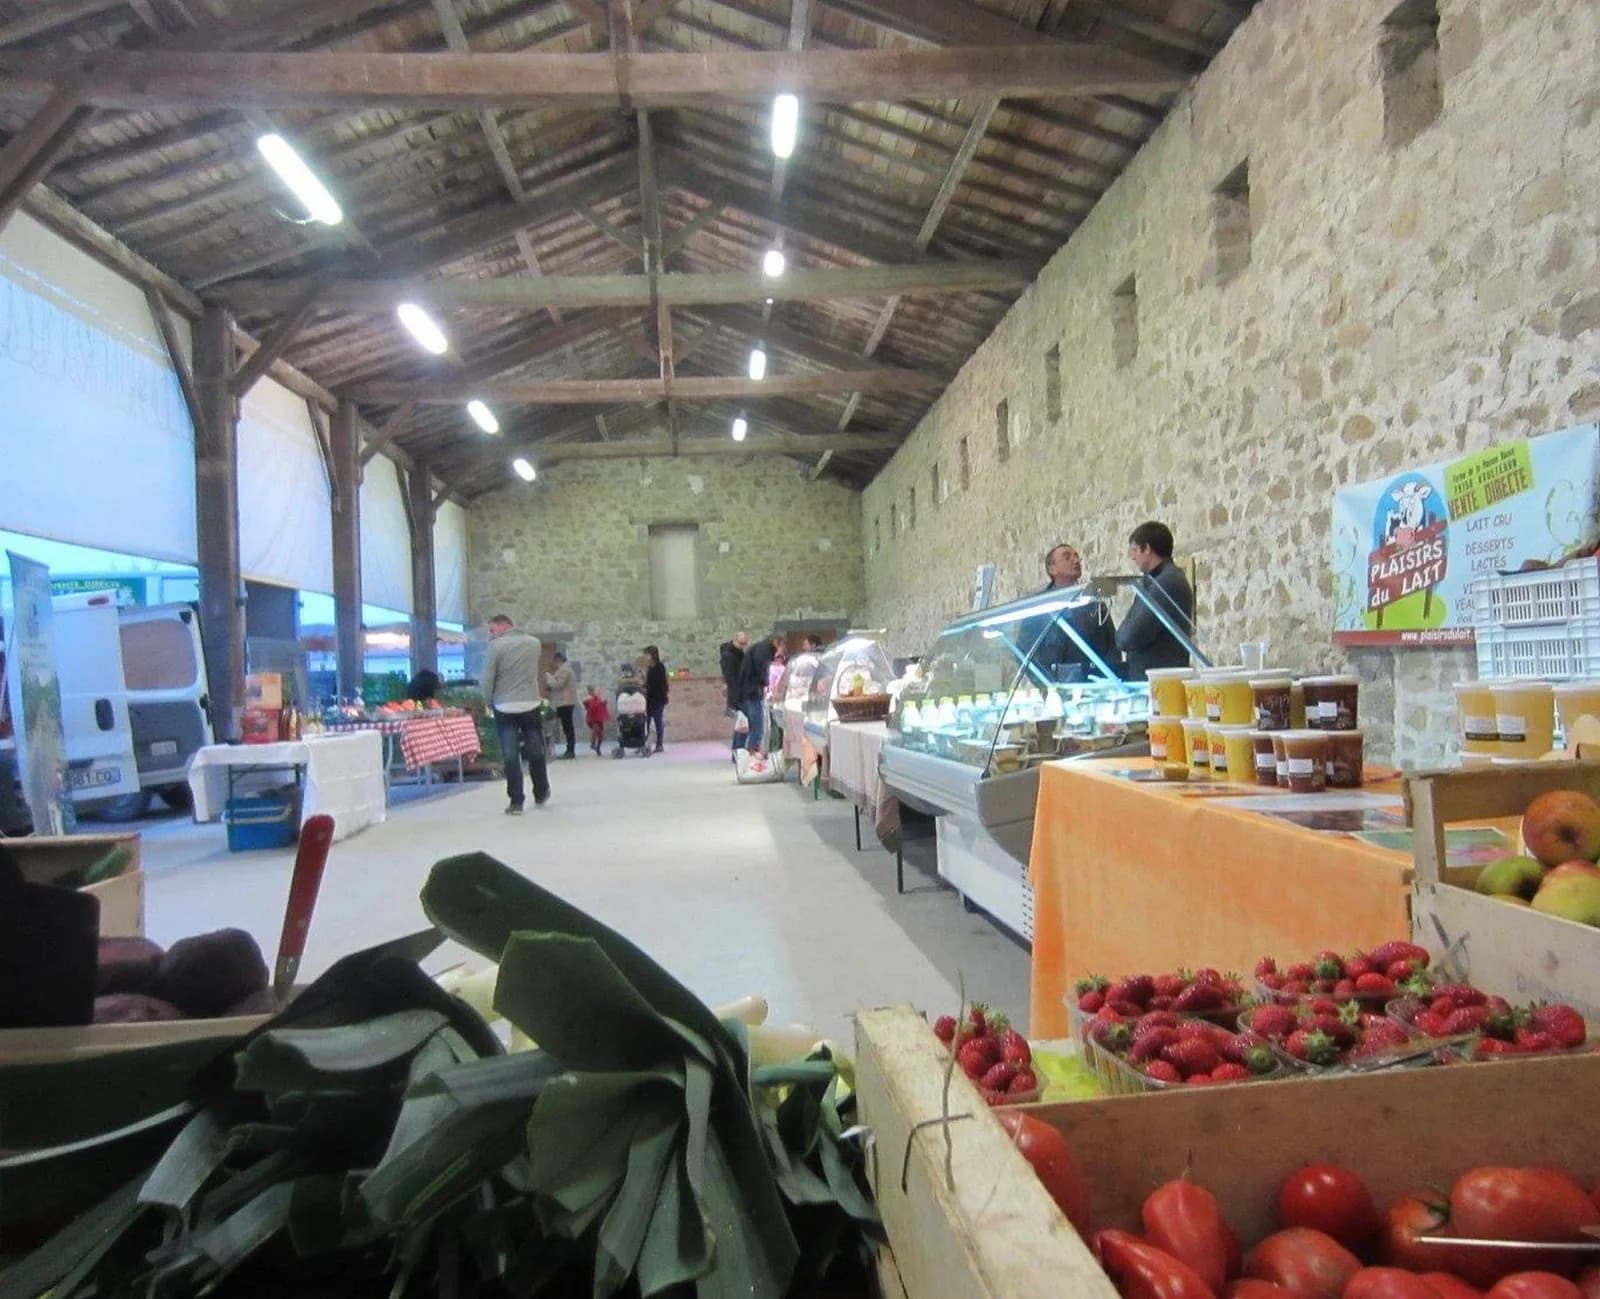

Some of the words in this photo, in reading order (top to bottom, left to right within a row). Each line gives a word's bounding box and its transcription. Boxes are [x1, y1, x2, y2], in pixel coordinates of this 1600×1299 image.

[1448, 488, 1479, 521] VENTE
[1483, 466, 1529, 504] DIRECTE
[1466, 517, 1490, 532] LAIT
[1493, 513, 1512, 527] CRU
[1371, 539, 1443, 583] PLAISIRS
[1465, 536, 1514, 555] DESSERTS
[1371, 587, 1390, 607] du
[1401, 559, 1442, 595] LAIT
[1401, 627, 1474, 643] www.plaisirsdulait.
